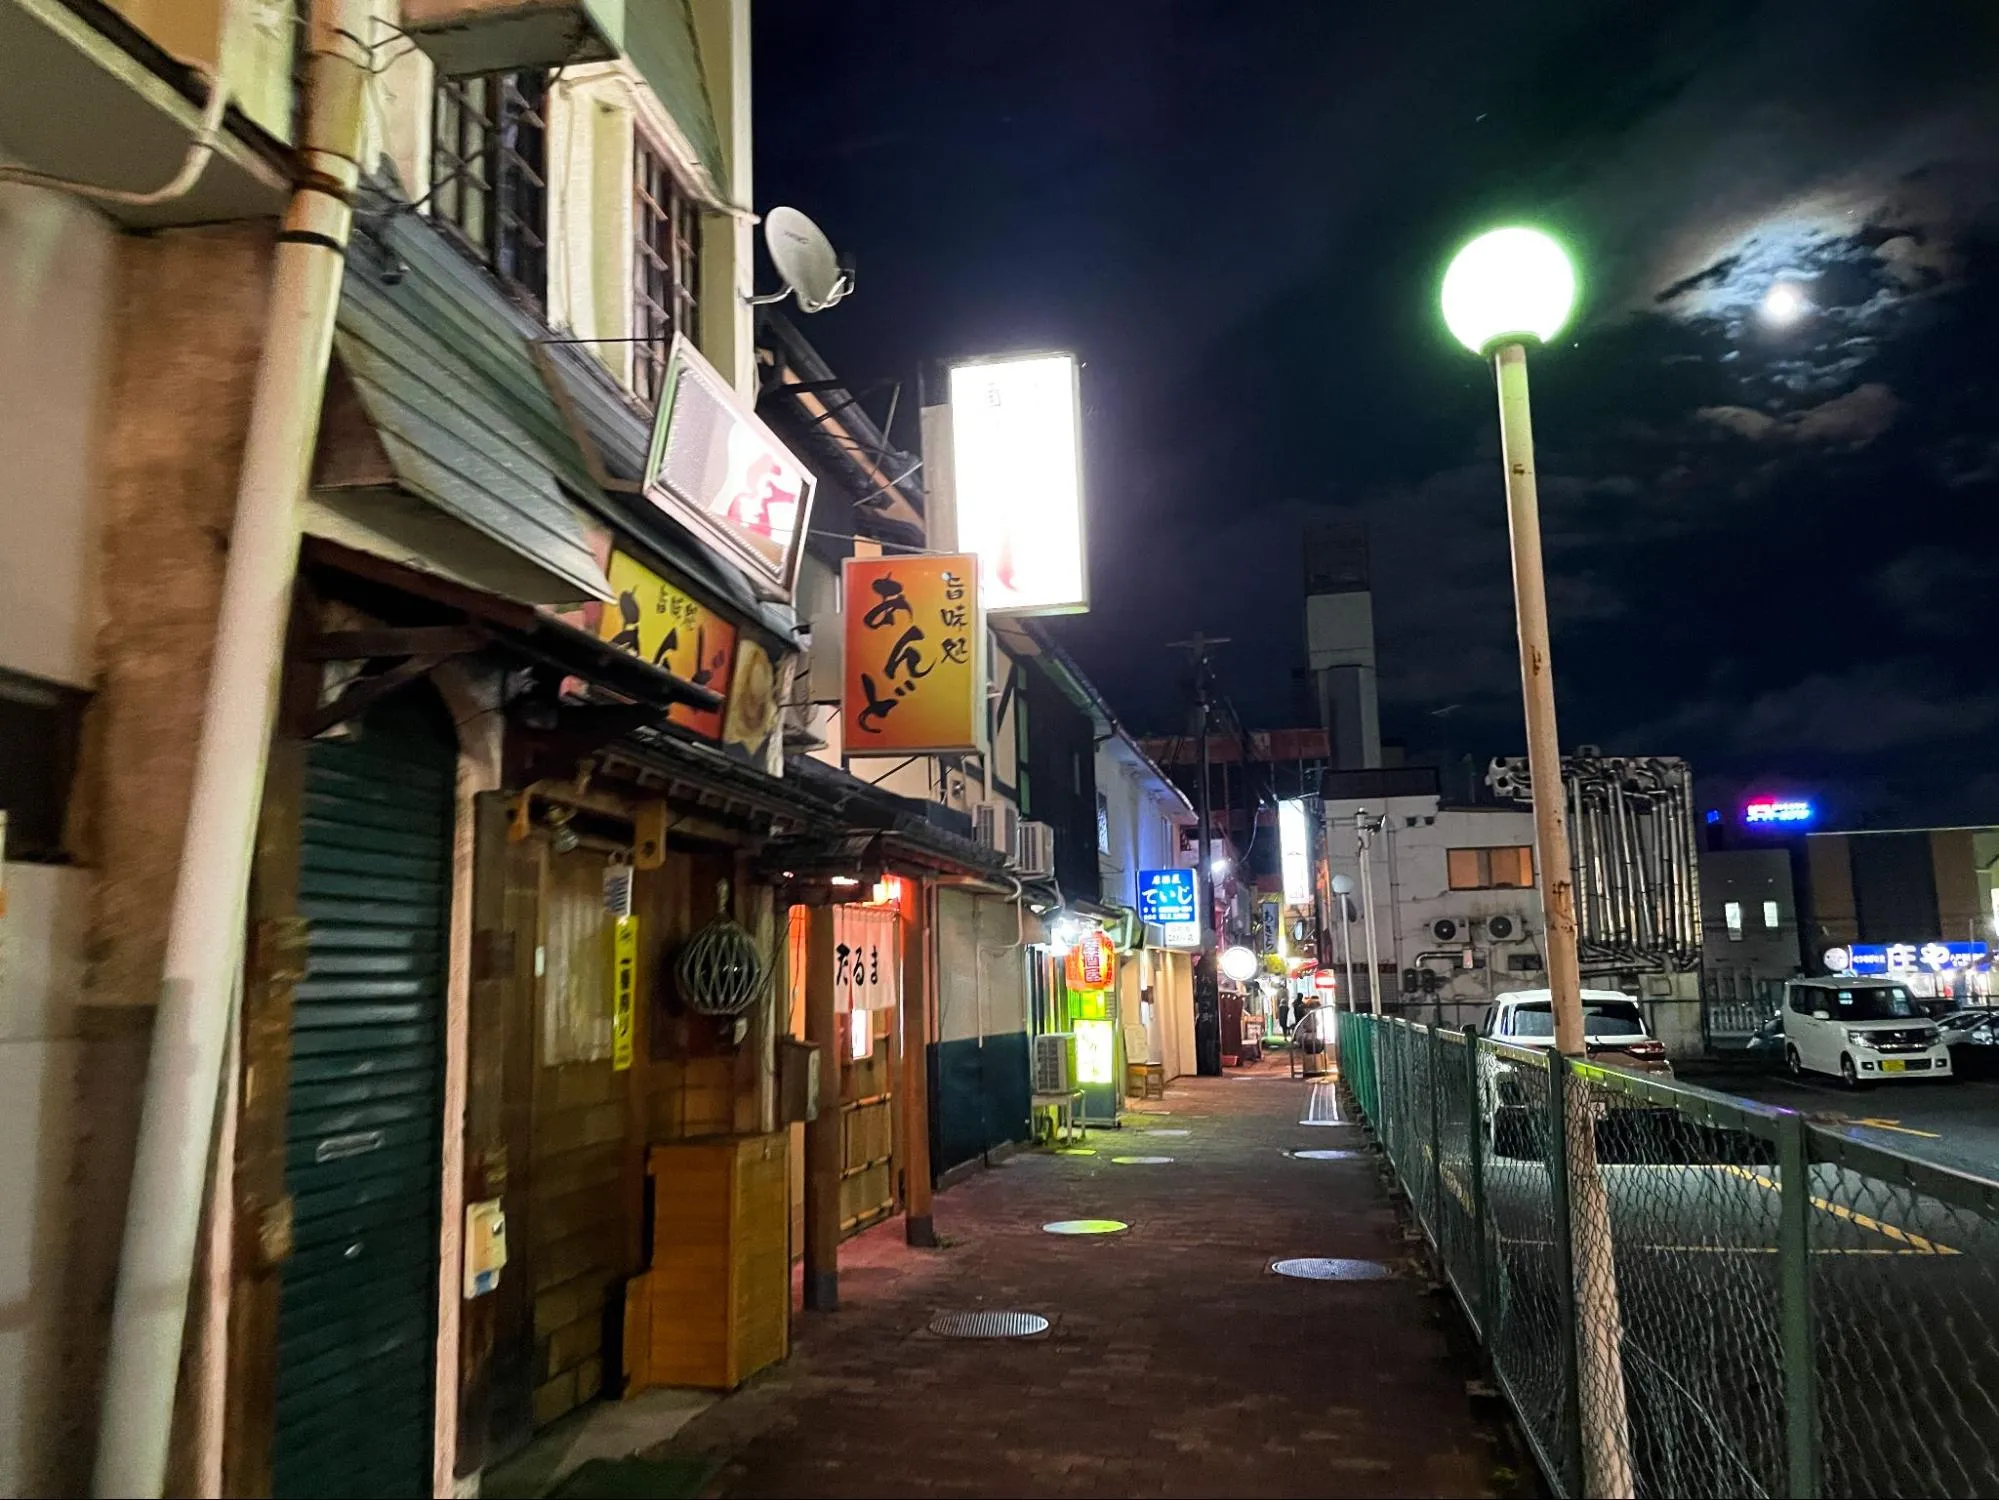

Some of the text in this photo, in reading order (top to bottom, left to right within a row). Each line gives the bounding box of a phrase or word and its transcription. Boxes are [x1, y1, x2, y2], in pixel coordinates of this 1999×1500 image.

[858, 571, 936, 733] あんど
[940, 572, 969, 664] 旨味処
[1142, 886, 1193, 905] ていじ
